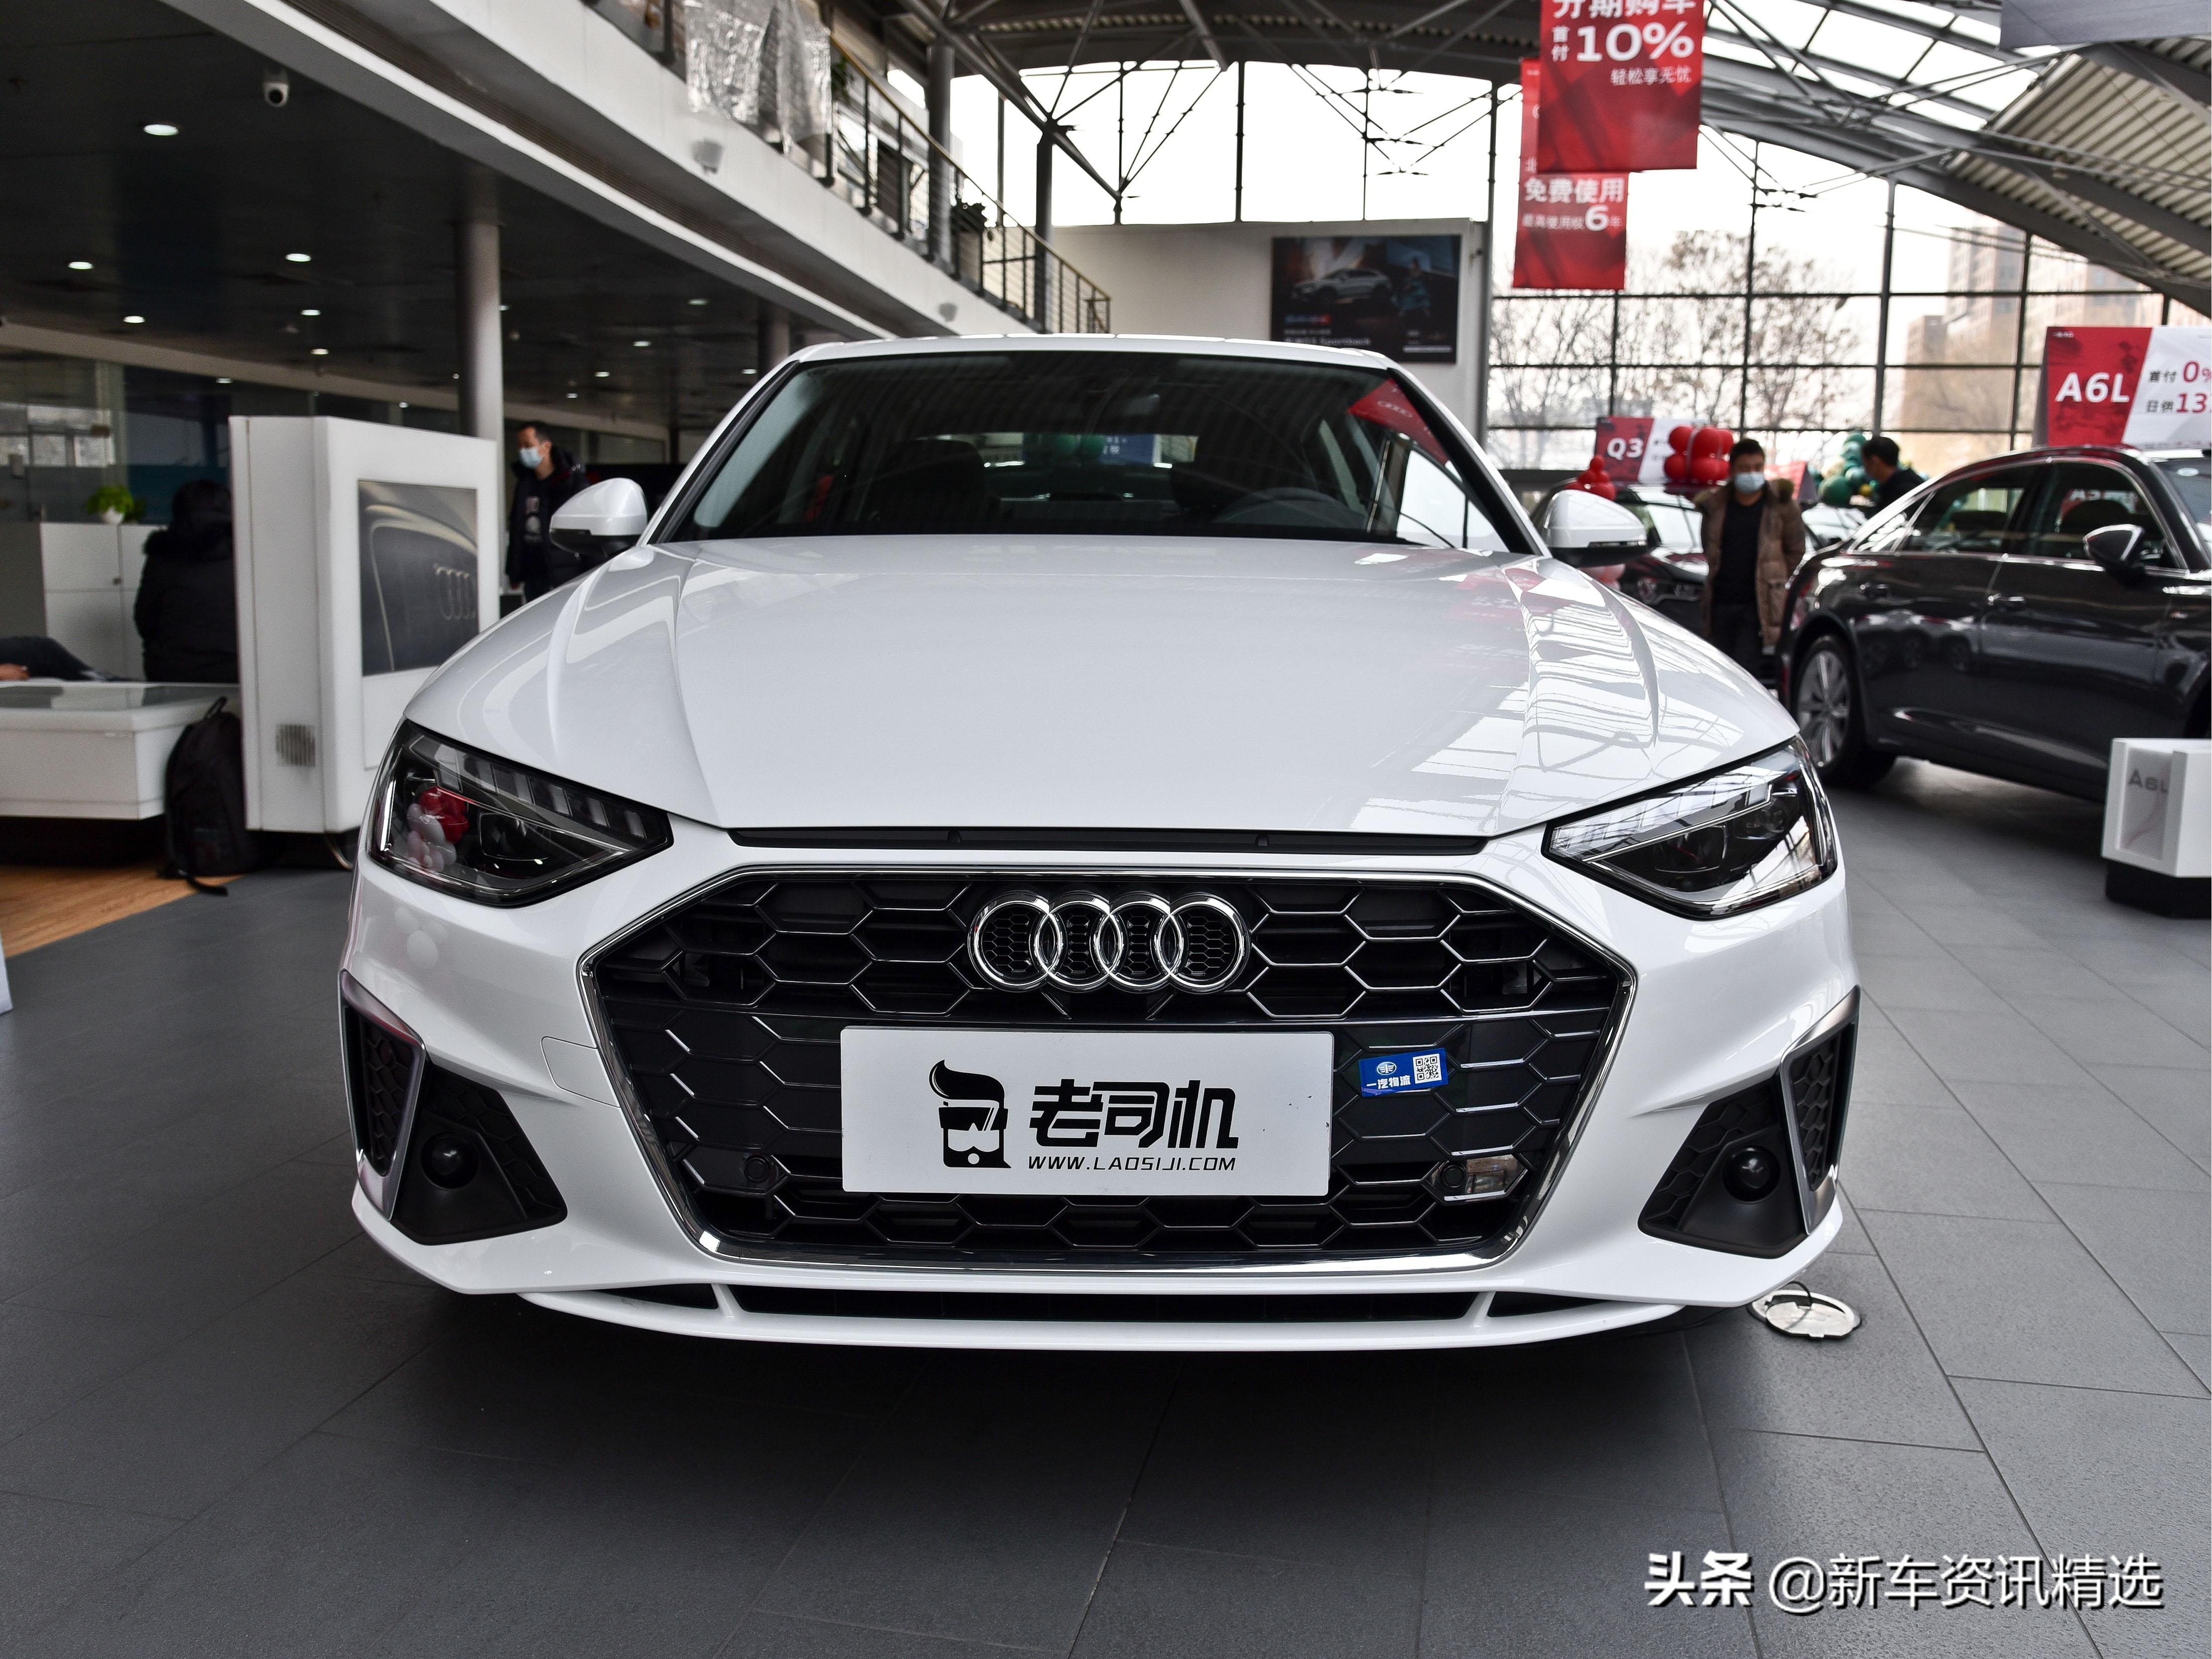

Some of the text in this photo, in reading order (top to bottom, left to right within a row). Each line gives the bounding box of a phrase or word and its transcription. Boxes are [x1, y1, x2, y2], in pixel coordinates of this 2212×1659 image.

[1551, 21, 1695, 62] 首付 10%
[1610, 65, 1692, 85] 轻松享无忧
[1524, 177, 1625, 203] 免费使用
[2055, 372, 2130, 403] A6L
[2177, 393, 2211, 413] 13
[1607, 437, 1643, 460] Q3
[1366, 1075, 1411, 1089] 一汽物流
[1029, 1079, 1239, 1149] 老司机
[1029, 1156, 1236, 1172] WWW.LAOSIJI.COM
